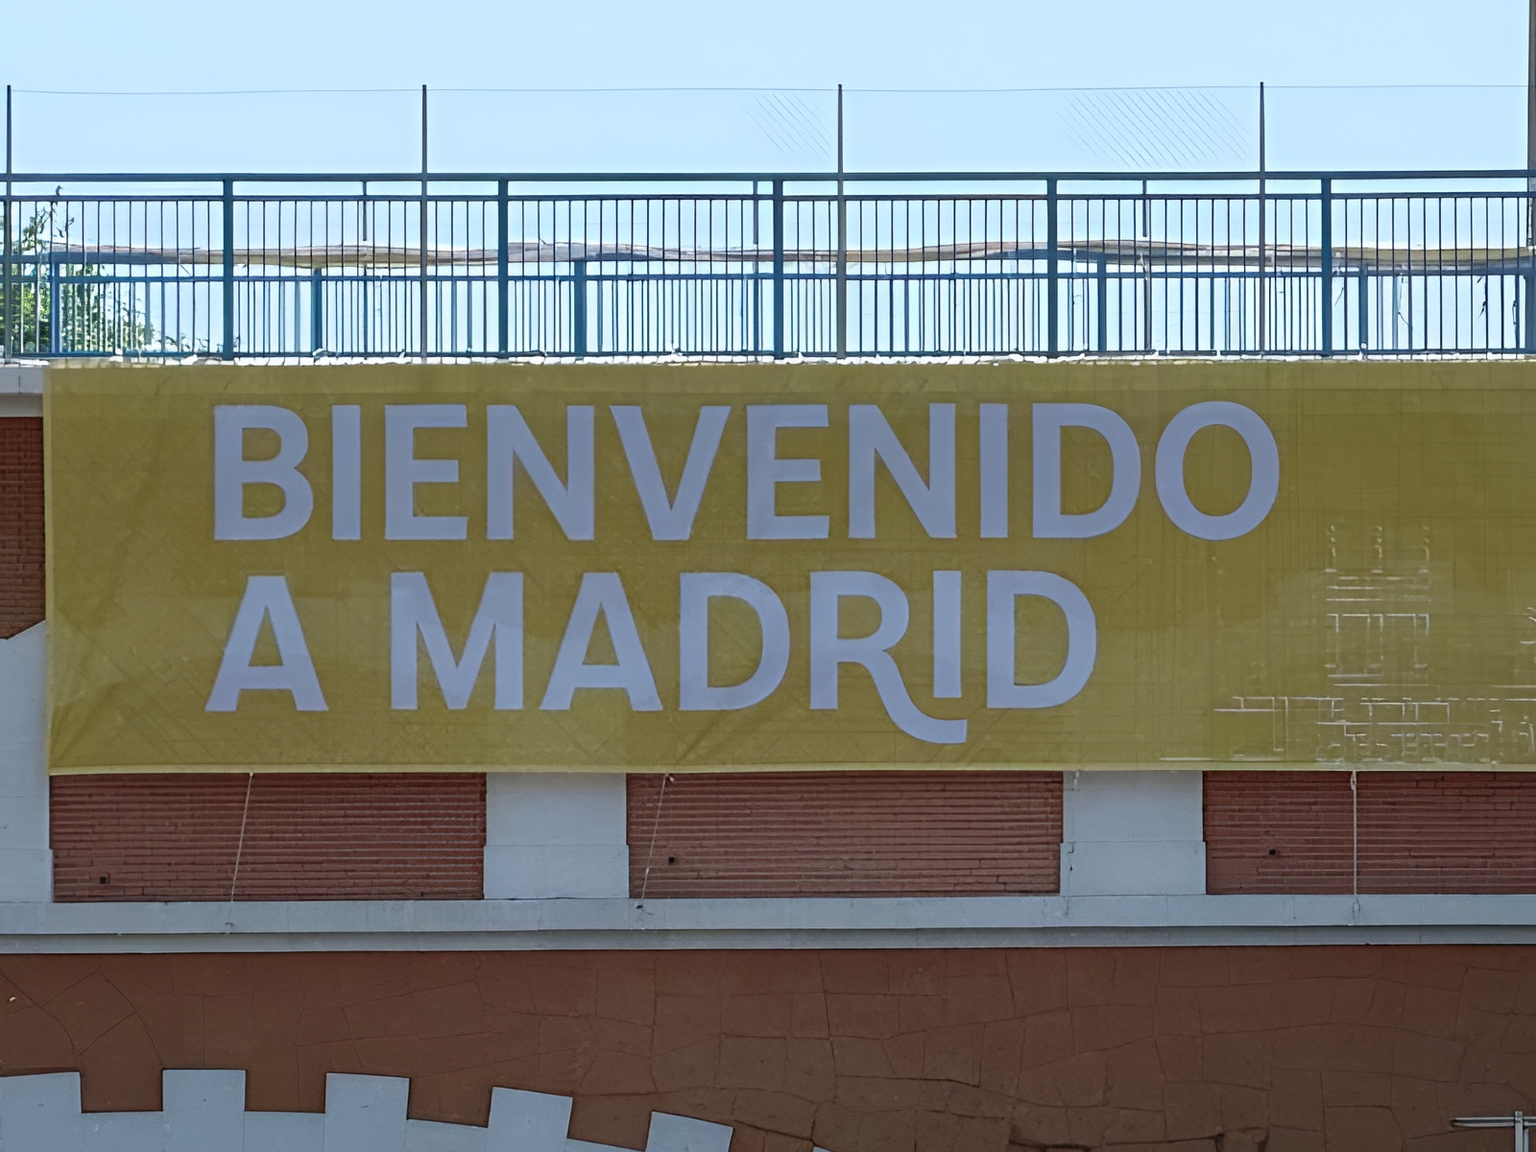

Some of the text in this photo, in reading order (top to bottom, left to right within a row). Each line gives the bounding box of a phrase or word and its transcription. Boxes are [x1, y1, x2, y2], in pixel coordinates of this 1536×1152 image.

[213, 401, 1280, 541] BIENVENIDO
[205, 570, 1098, 745] A MADRID
